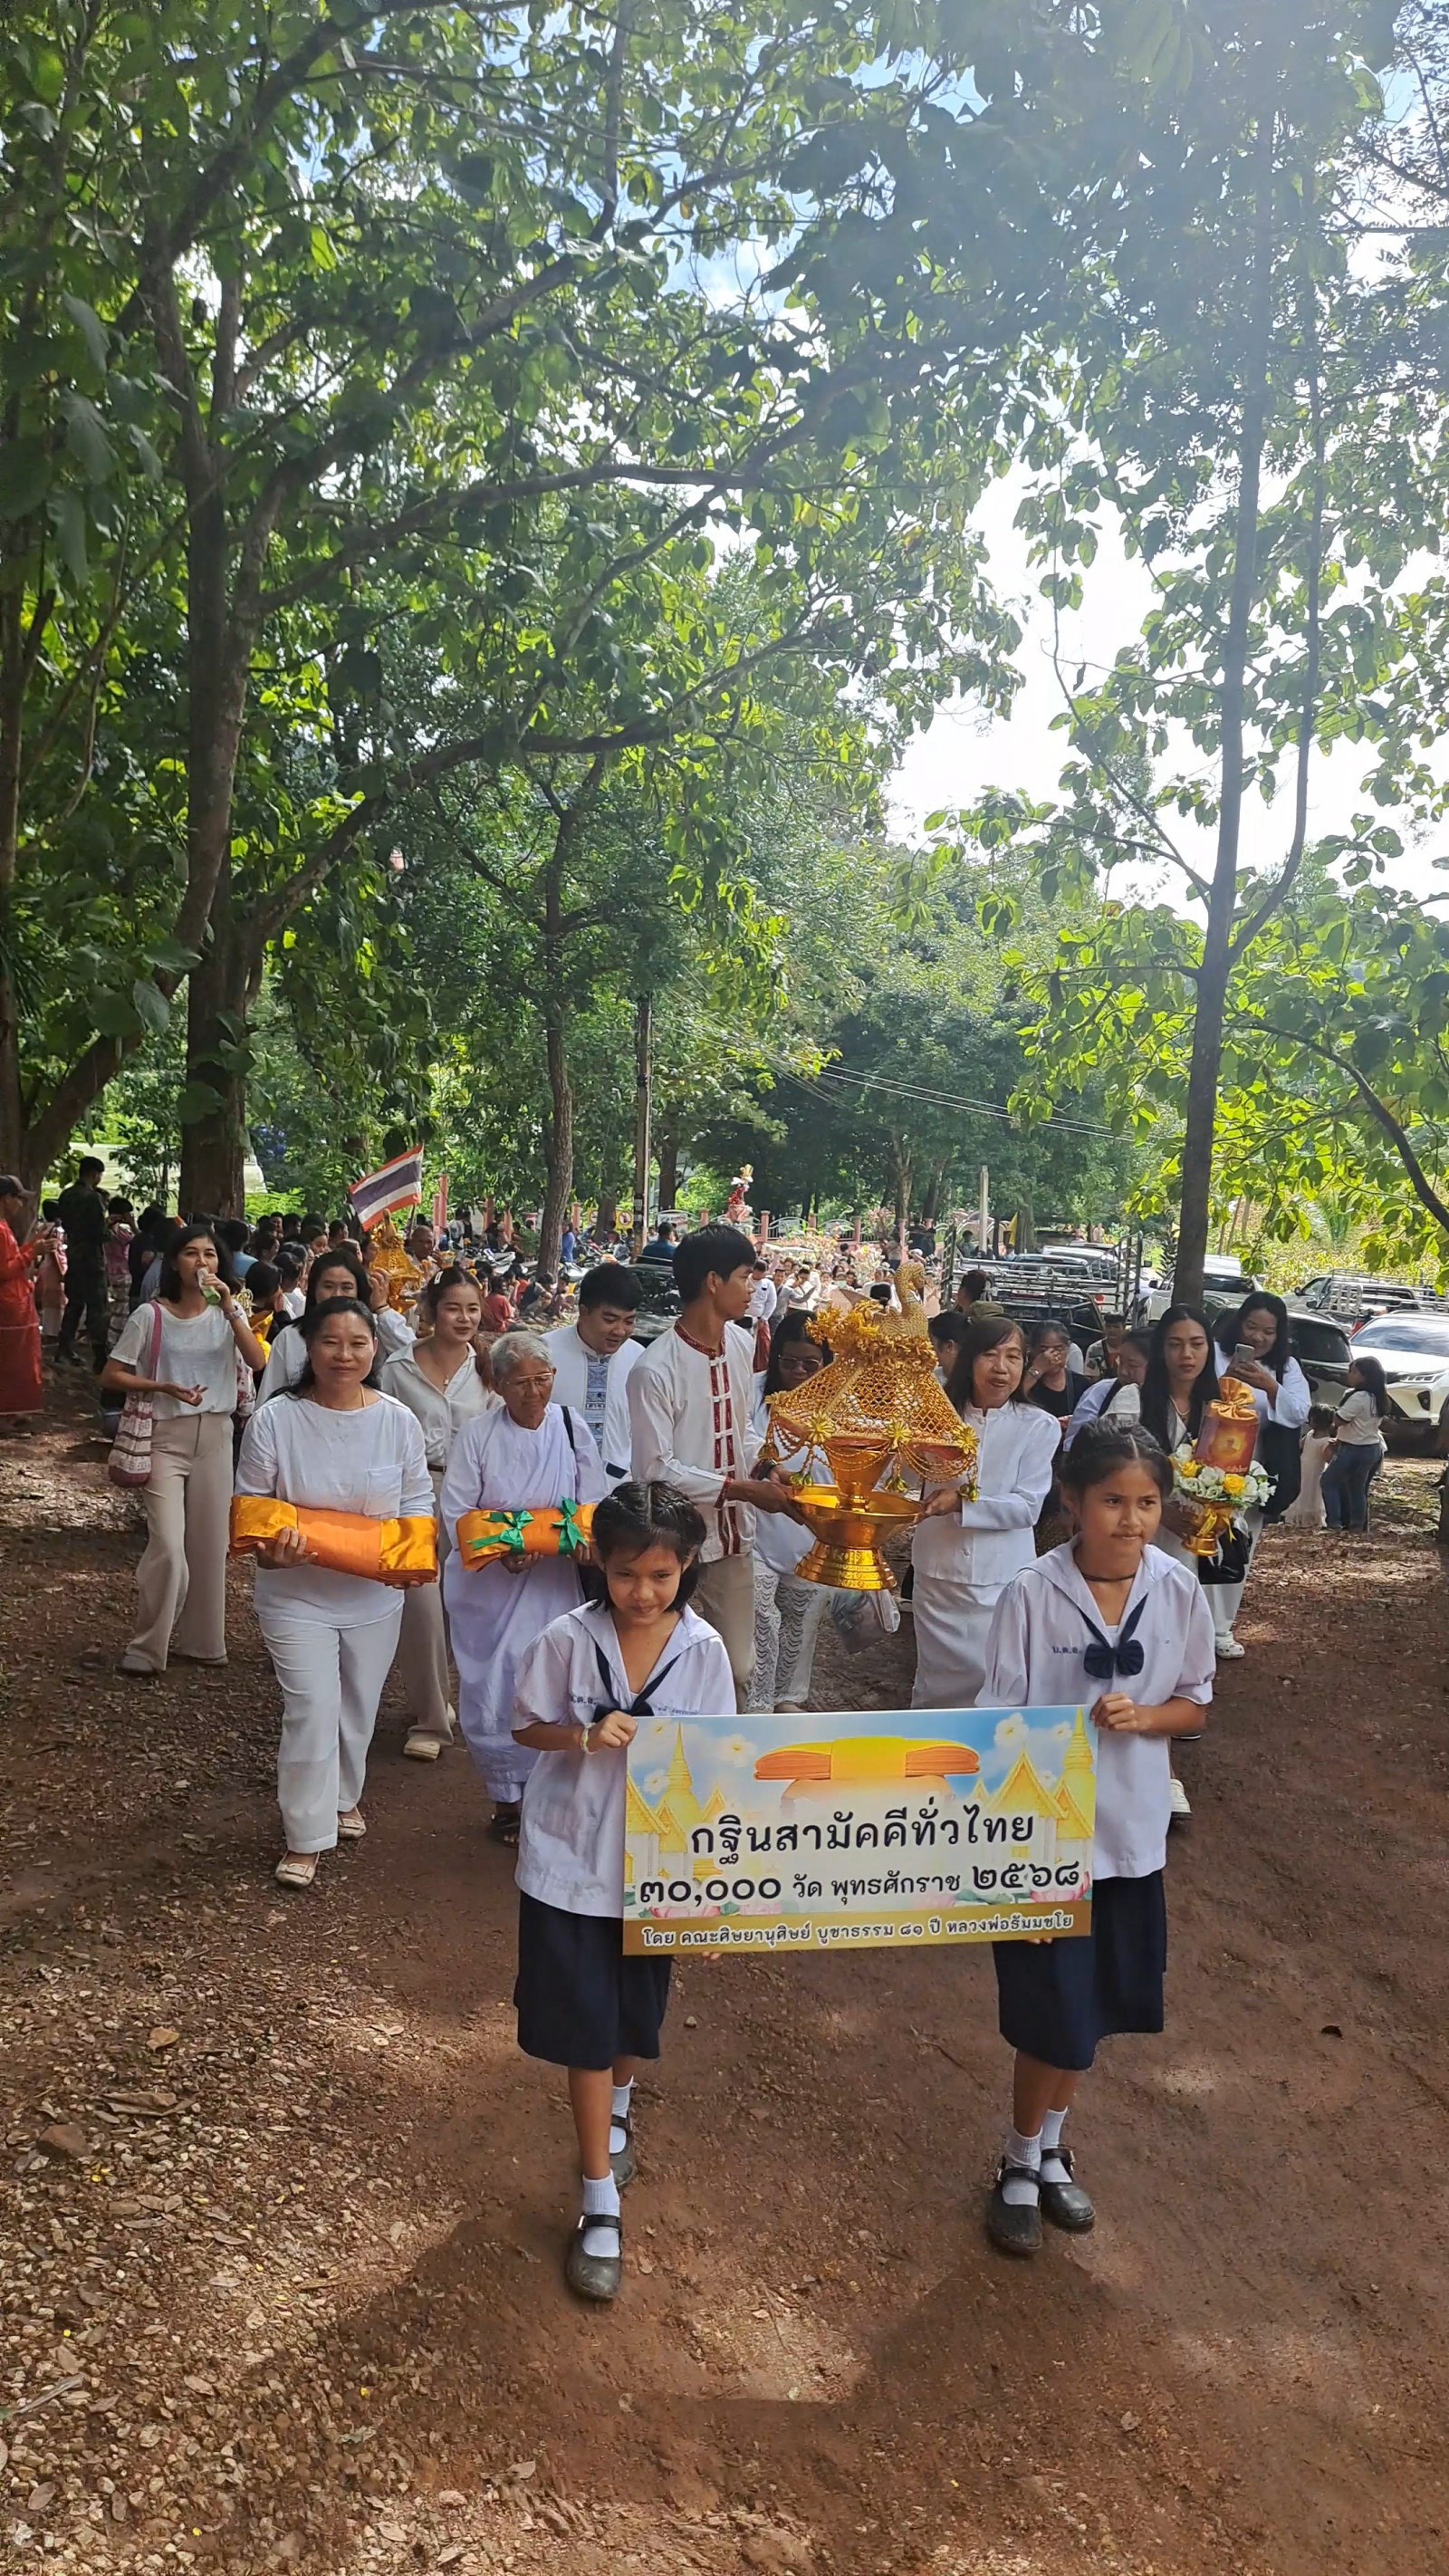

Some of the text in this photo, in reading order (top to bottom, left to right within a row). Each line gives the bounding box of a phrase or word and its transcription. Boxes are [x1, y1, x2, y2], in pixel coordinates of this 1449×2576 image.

[691, 1796, 1033, 1865] กฐินสามัคคีทั่วไทย
[640, 1860, 1080, 1907] ๓๐,๐๐๐ วัด พุทธศักราช ๒๕๖๘
[643, 1910, 1073, 1946] โดย คณะศิษยานุศิษย์ บูชาธรรม ๘๑ ปี หลวงพ่อธัมมชโย
